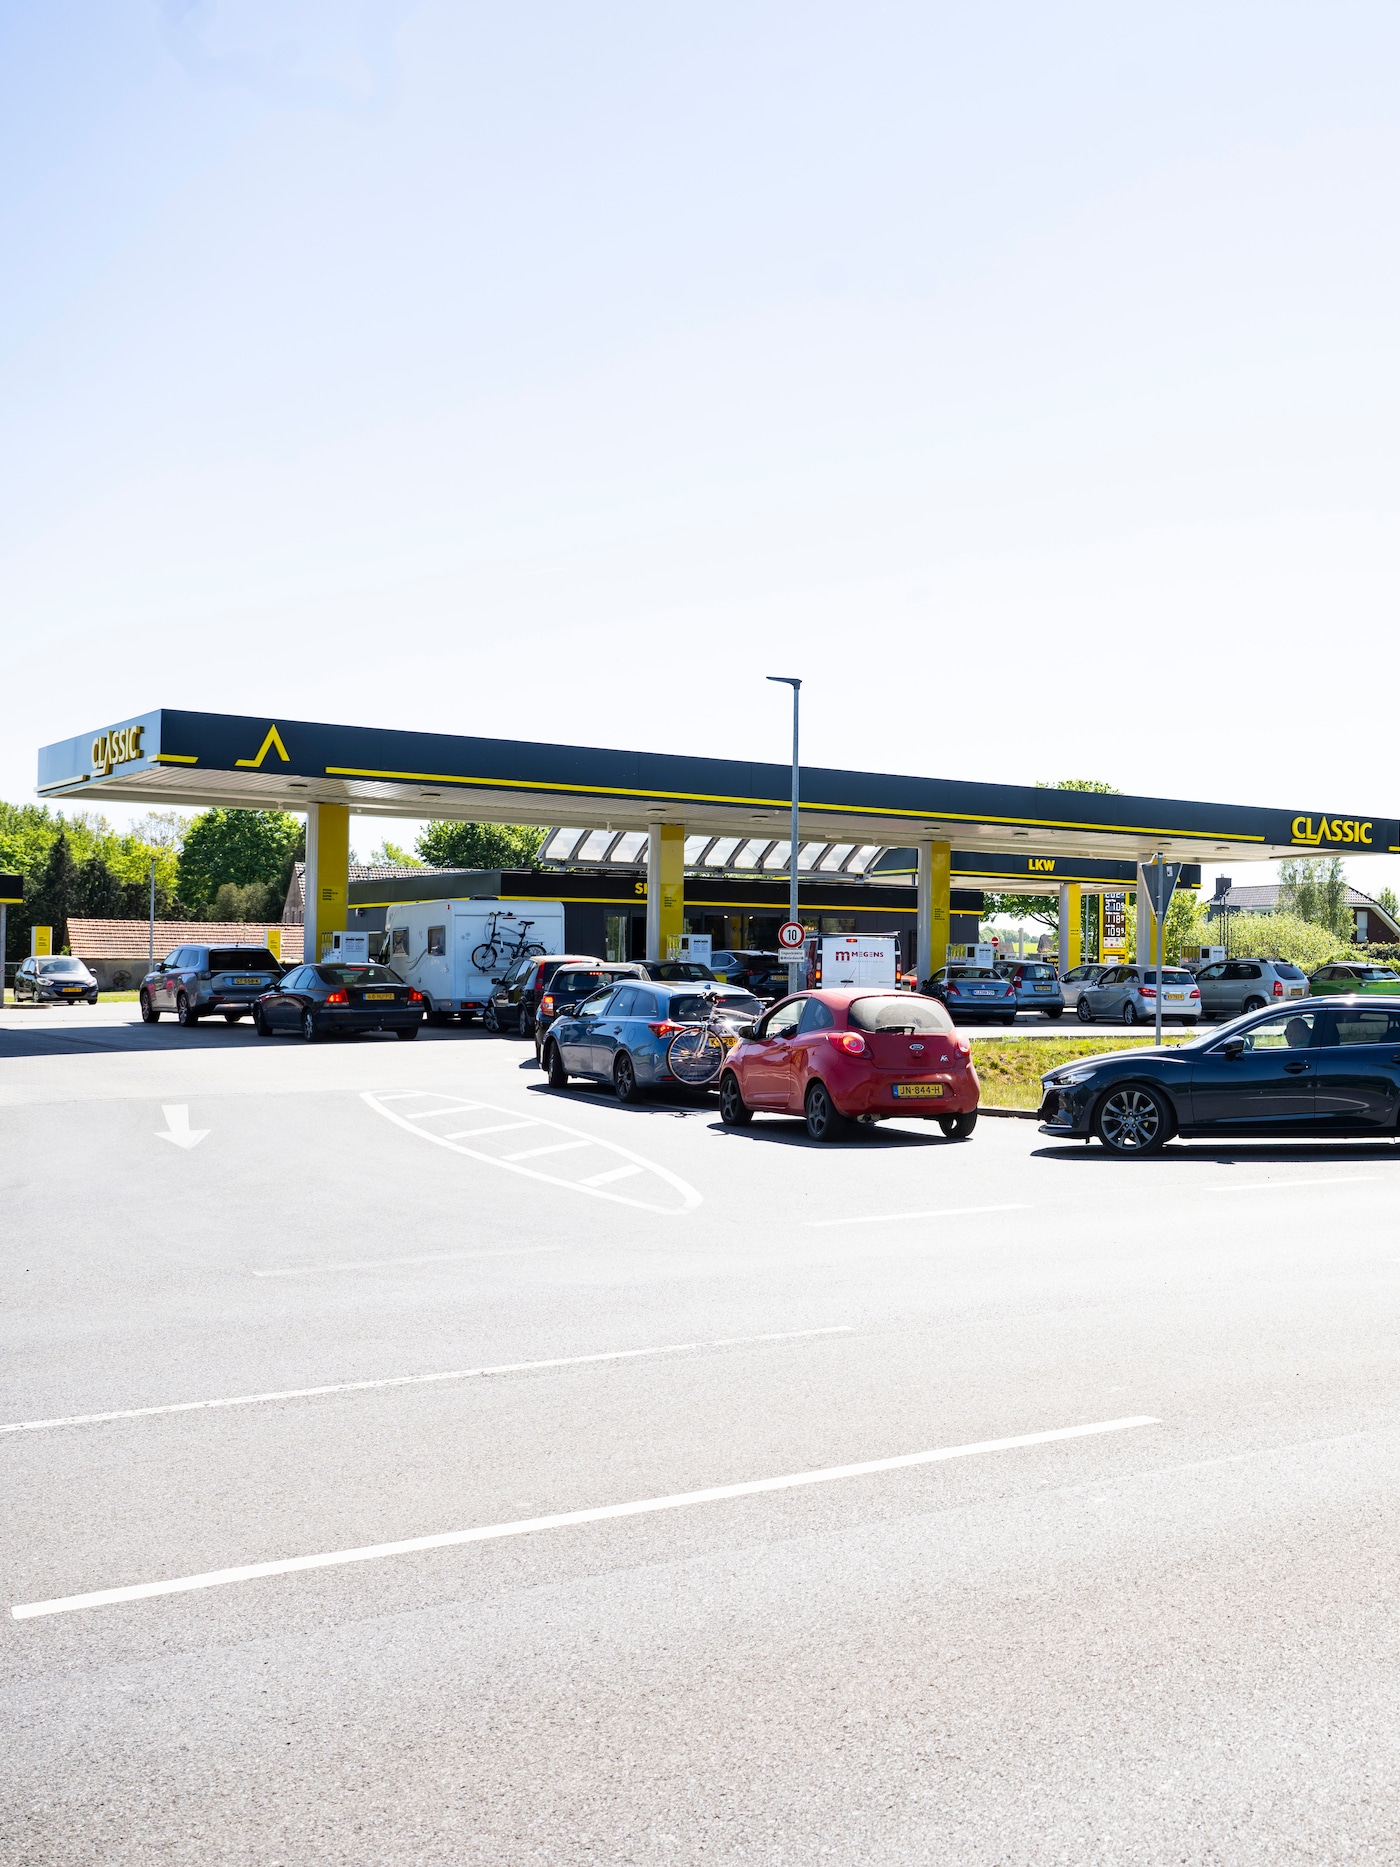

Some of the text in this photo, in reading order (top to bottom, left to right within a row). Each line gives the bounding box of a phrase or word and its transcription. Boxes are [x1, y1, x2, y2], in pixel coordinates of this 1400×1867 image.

[91, 725, 145, 777] CLASSIC
[1290, 815, 1373, 845] CLASSIC
[1028, 858, 1055, 872] LKW
[787, 929, 797, 941] 10
[900, 1086, 940, 1095] JN-844-H
